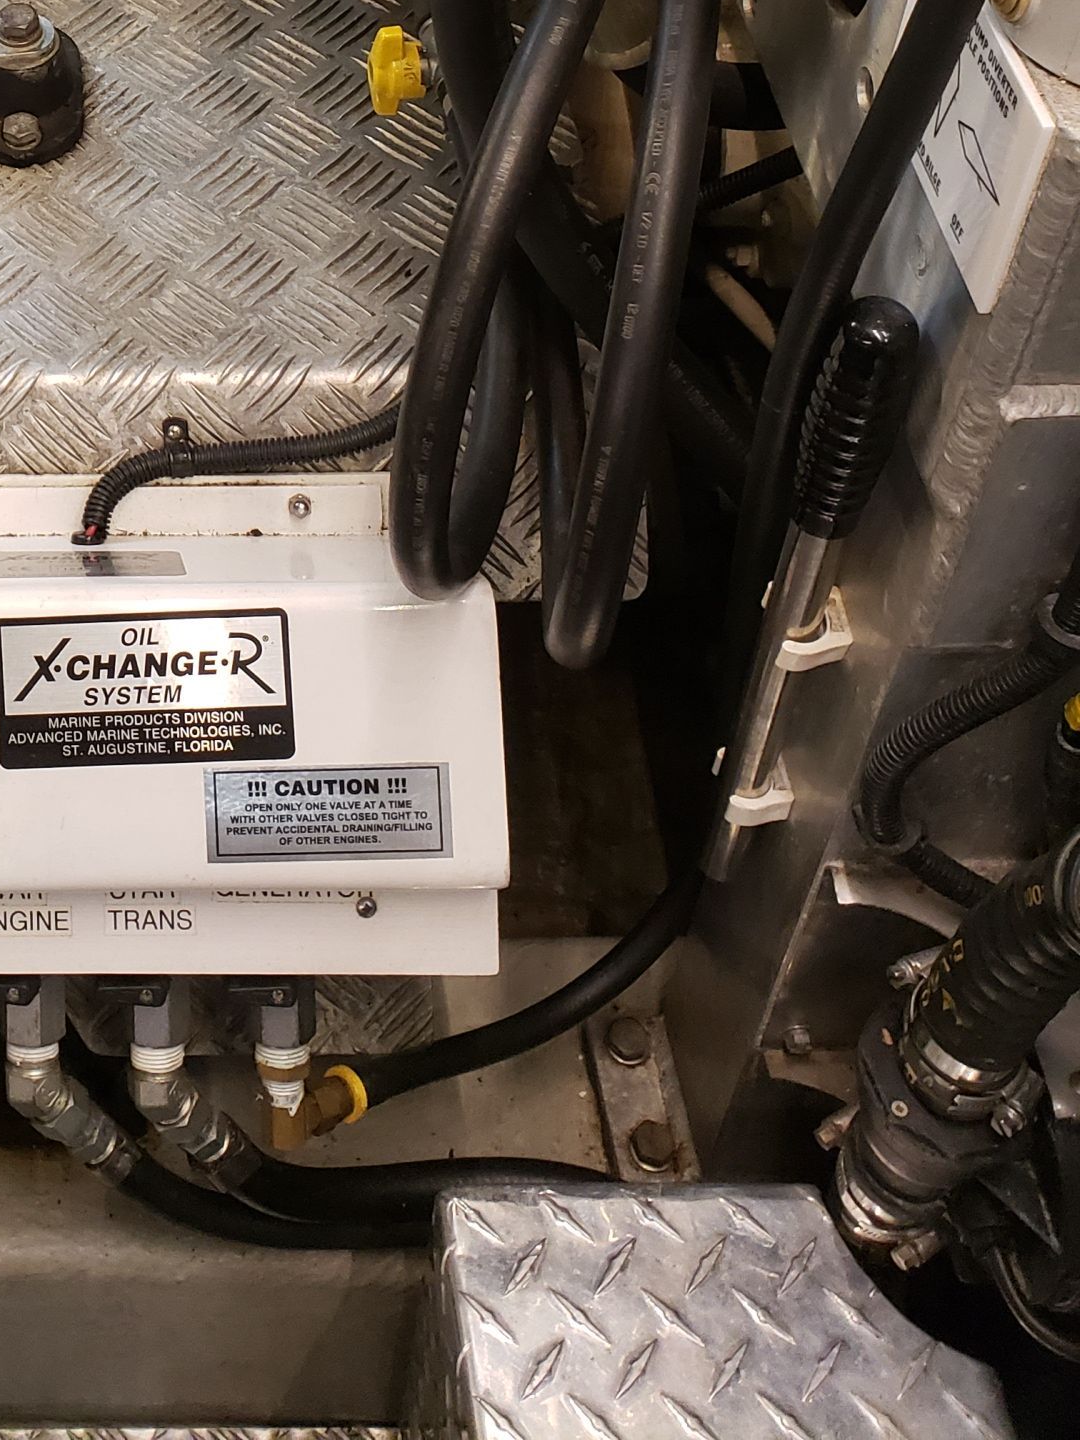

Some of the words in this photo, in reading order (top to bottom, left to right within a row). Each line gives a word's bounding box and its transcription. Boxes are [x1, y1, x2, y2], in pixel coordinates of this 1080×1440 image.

[973, 22, 989, 51] UMP
[988, 48, 1018, 111] DIVERTER
[977, 54, 1010, 118] POSITIONS
[925, 155, 941, 191] BILGE
[951, 213, 964, 237] OFF
[121, 627, 160, 647] OIL
[83, 685, 183, 707] SYSTEM
[48, 716, 101, 729] MARINE
[105, 713, 181, 727] PRODUCTS
[184, 711, 244, 724] DIVISION
[8, 730, 83, 745] ADVANCED
[87, 728, 140, 741] MARINE
[143, 724, 255, 740] TECHNOLOGIES,
[258, 723, 287, 736] INC.
[62, 745, 84, 757] ST.
[87, 742, 171, 756] AUGUSTINE,
[174, 739, 234, 753] FLORIDA
[274, 778, 380, 797] CAUTION
[244, 803, 273, 812] OPEN
[275, 802, 302, 811] ONLY
[305, 802, 327, 811] ONE
[329, 801, 361, 810] VALVE
[363, 800, 376, 809] AT
[378, 800, 386, 809] A
[388, 800, 413, 809] TIME
[230, 815, 256, 824] WITH
[258, 814, 293, 823] OTHER
[296, 813, 335, 822] VALVES
[337, 812, 379, 821] CLOSED
[381, 811, 411, 820] TIGHT
[414, 811, 428, 819] TO
[226, 826, 273, 836] PREVENT
[275, 824, 340, 834] ACCIDENTAL
[342, 822, 433, 833] DRAINING/FILLING
[279, 837, 295, 846] OF
[296, 836, 331, 845] OTHER
[333, 835, 382, 844] ENGINES.
[107, 909, 193, 931] TRANS
